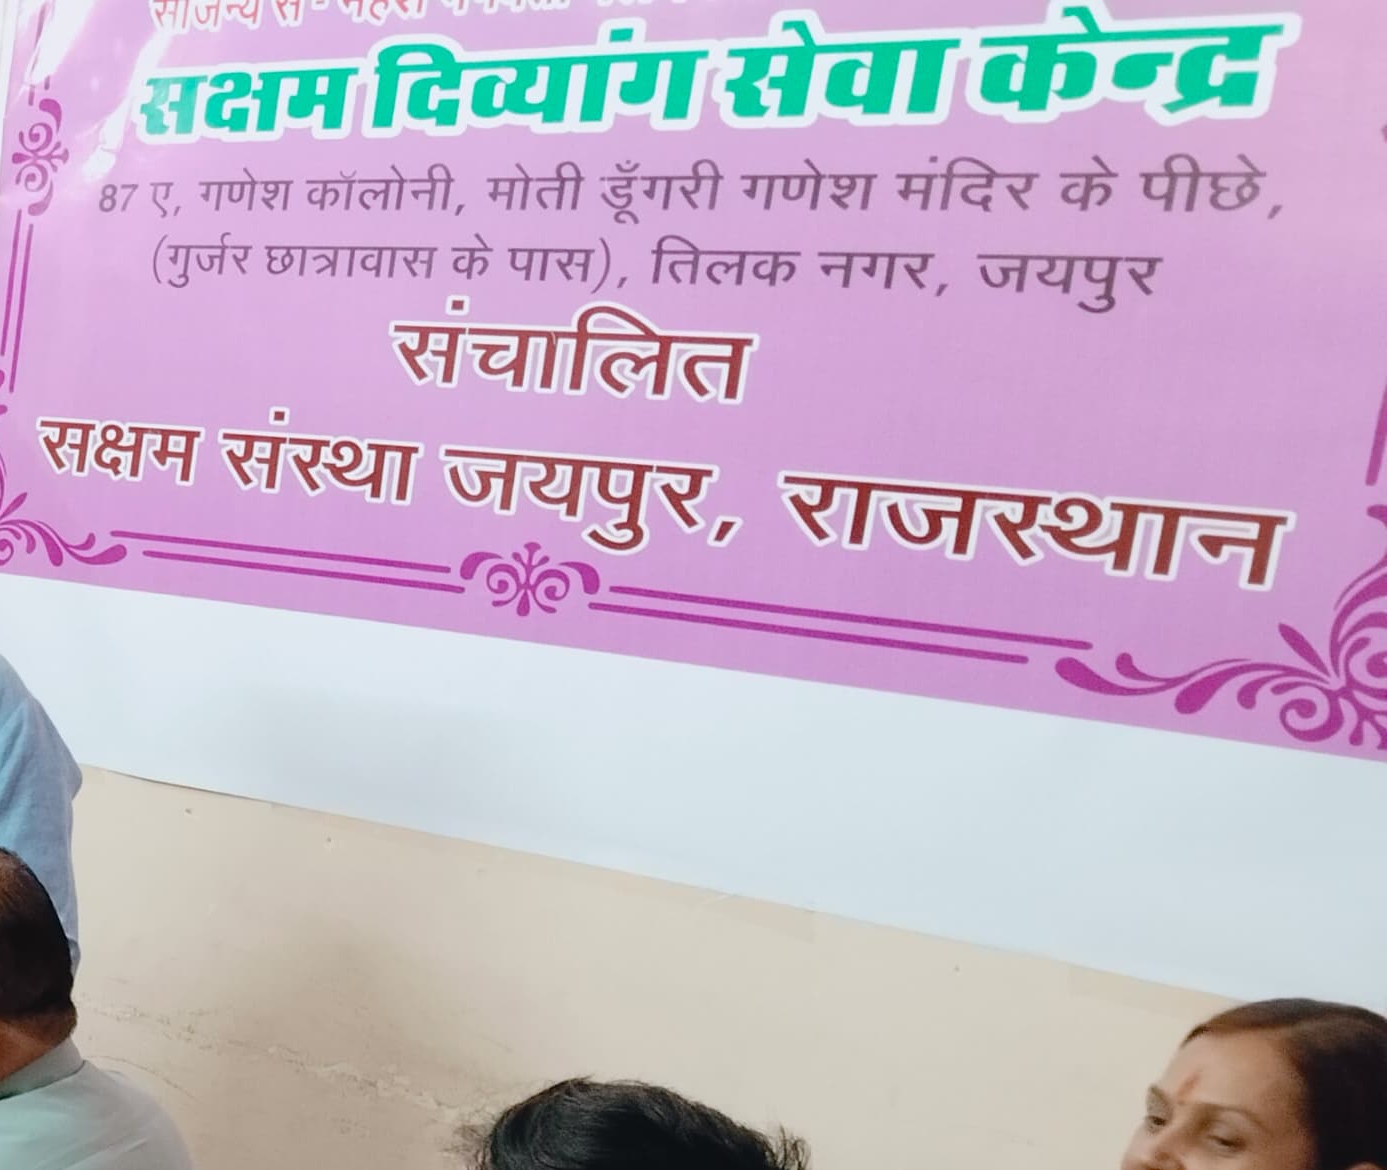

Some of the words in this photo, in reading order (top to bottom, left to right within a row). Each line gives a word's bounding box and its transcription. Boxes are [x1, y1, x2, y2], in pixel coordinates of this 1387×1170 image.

[138, 64, 359, 135] सक्षम
[371, 27, 710, 129] दिव्यांग
[722, 20, 962, 118] सेवा
[978, 7, 1285, 114] केन्द्र
[98, 183, 138, 214] 87
[198, 168, 293, 213] गणेश
[306, 164, 466, 217] कॉलोनी,
[487, 161, 584, 212] मोती
[740, 159, 878, 212] गणेश
[896, 155, 1041, 213] मंदिर
[1060, 155, 1119, 212] के
[1139, 153, 1285, 221] पीछे,
[152, 232, 253, 290] (गुर्जर
[264, 242, 435, 281] छात्रावास
[451, 233, 492, 281] के
[507, 237, 629, 294] पास),
[650, 234, 802, 287] तिलक
[818, 250, 950, 298] नगर,
[977, 252, 1164, 314] जयपुर
[393, 299, 755, 400] संचालित
[39, 419, 202, 482] सक्षम
[222, 410, 420, 502] संस्था
[444, 447, 739, 550] जयपुर,
[783, 475, 1287, 586] राजस्थान
